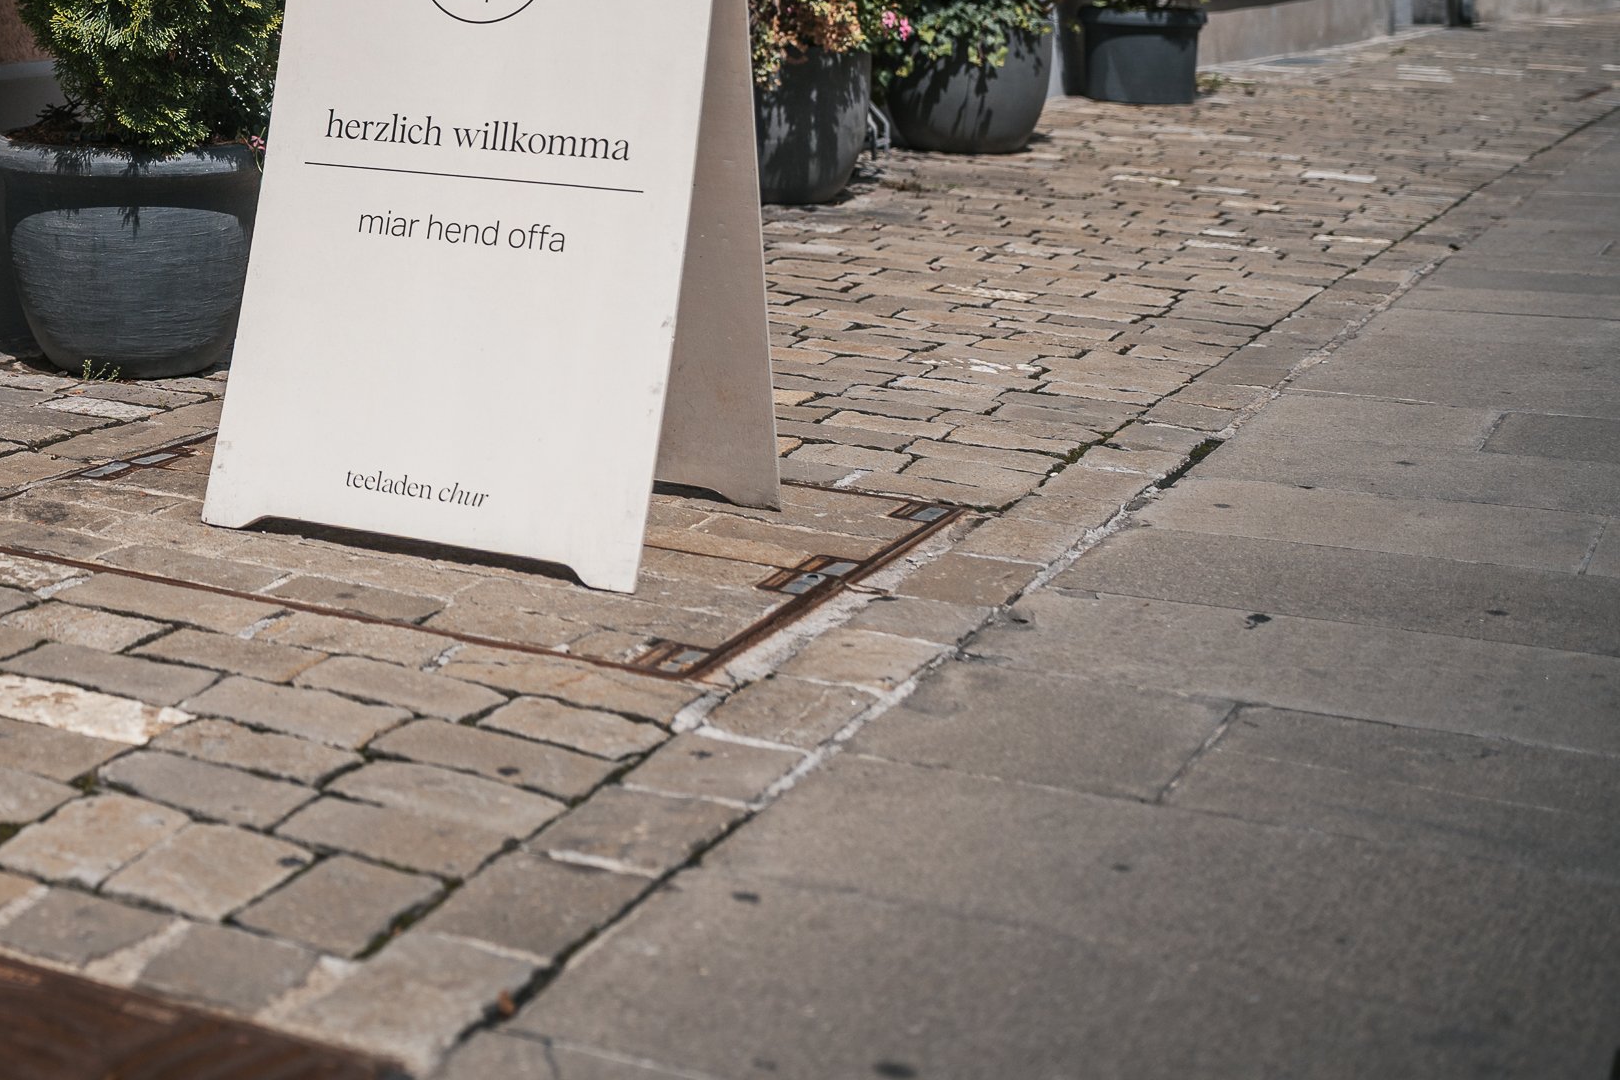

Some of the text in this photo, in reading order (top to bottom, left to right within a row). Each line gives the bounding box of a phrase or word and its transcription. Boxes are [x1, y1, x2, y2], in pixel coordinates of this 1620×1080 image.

[324, 108, 631, 162] herzlich willkomma
[357, 210, 566, 254] miar hend offa
[345, 469, 490, 508] teeladen chur
